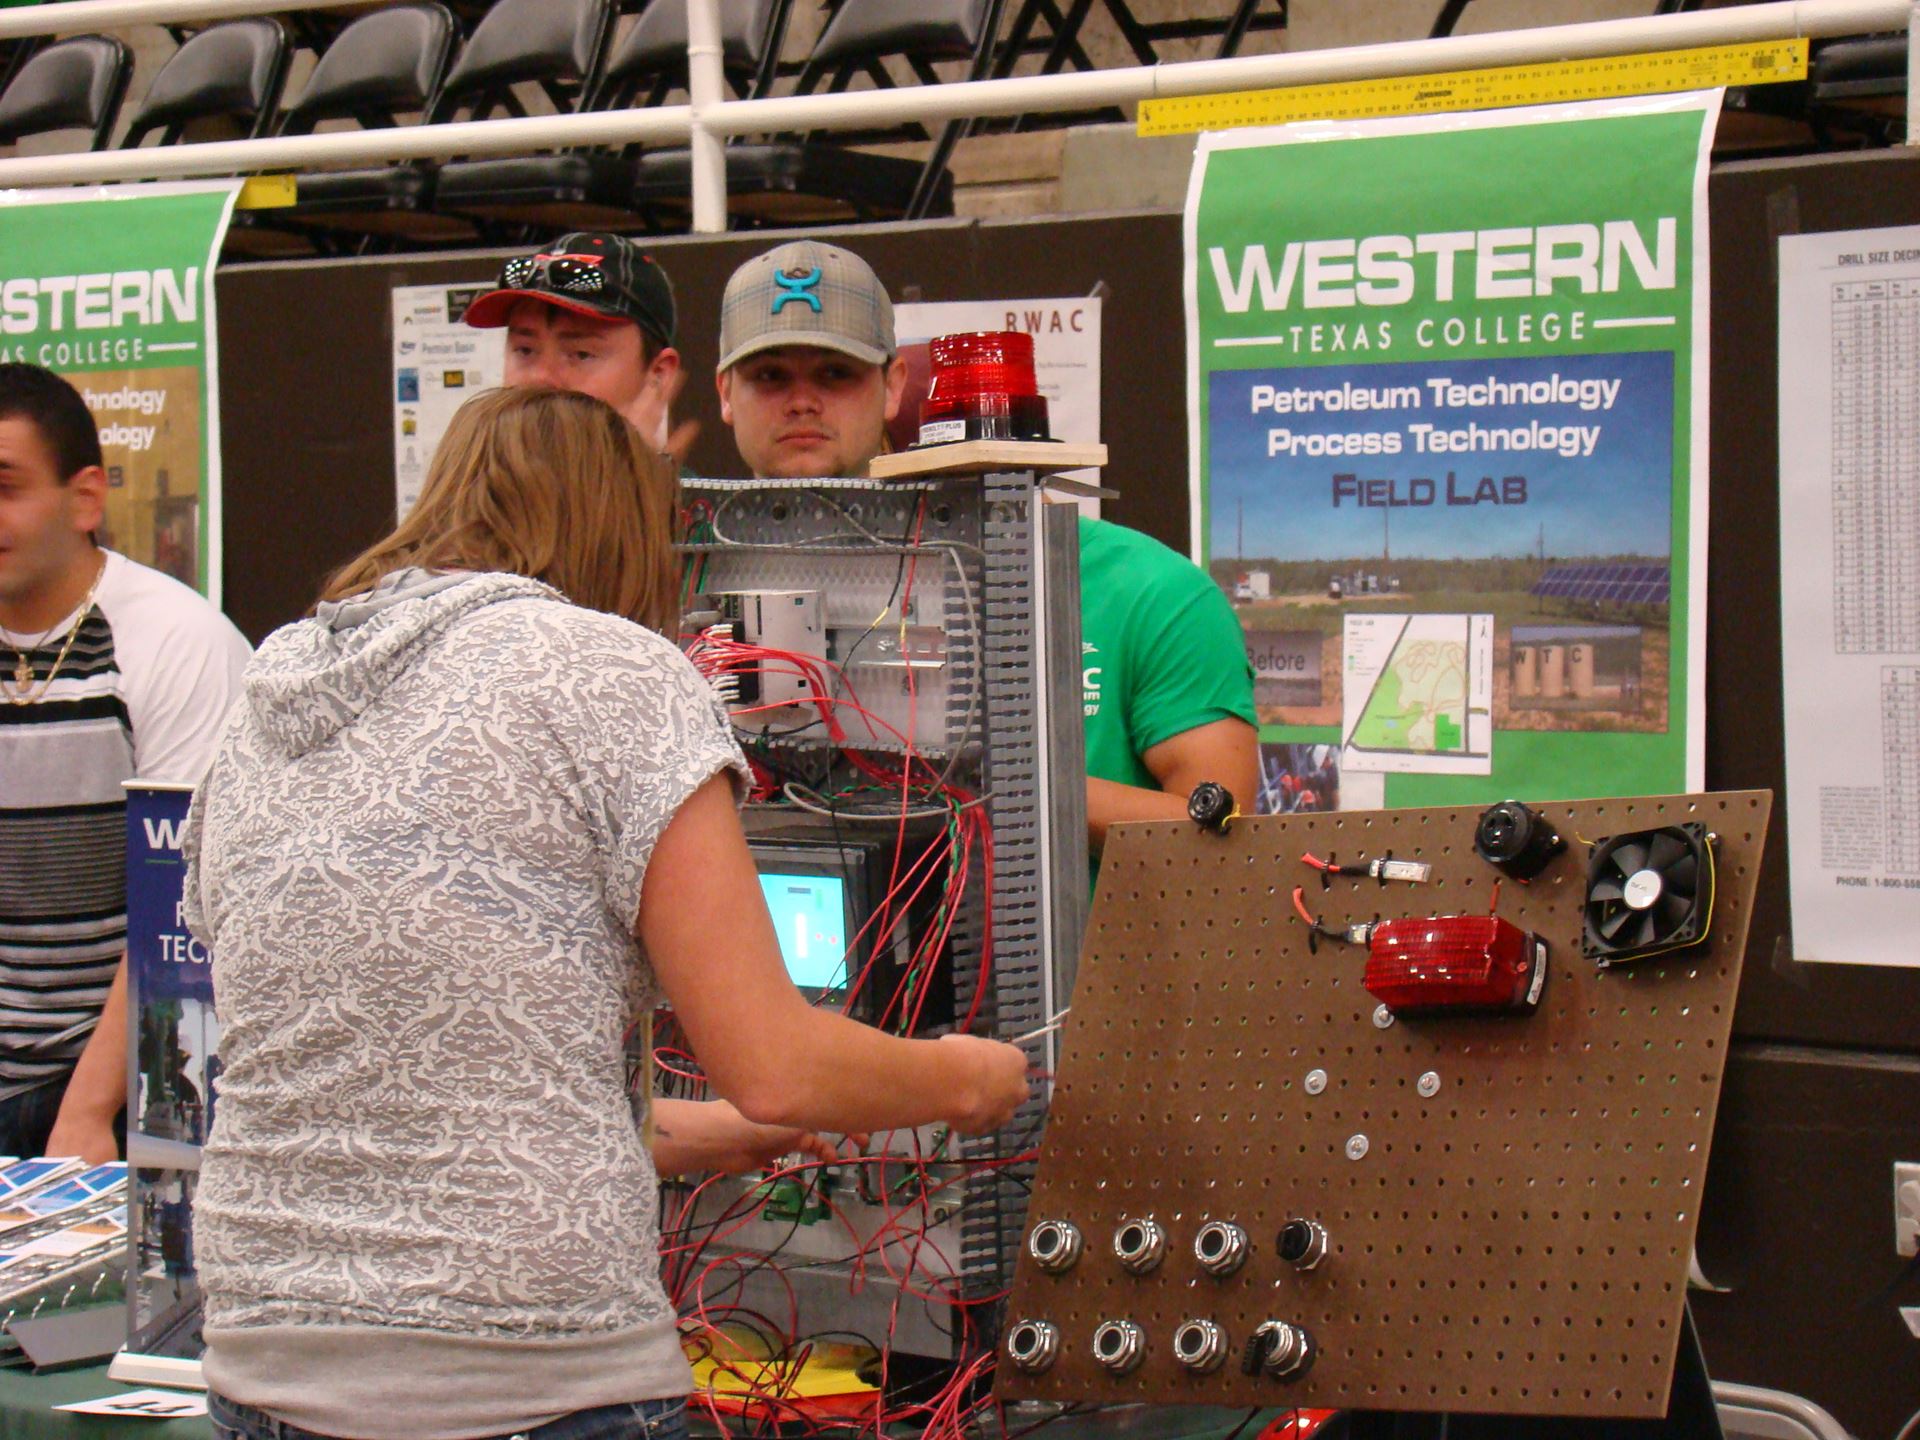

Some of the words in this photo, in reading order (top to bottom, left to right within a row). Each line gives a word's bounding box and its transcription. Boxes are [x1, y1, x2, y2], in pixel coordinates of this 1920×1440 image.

[1209, 217, 1676, 312] WESTERN
[1838, 254, 1864, 265] DRILL
[1868, 251, 1889, 263] SIZE
[0, 267, 198, 335] STERN
[1006, 309, 1083, 333] RWAC
[1291, 323, 1391, 354] TEXAS
[1416, 312, 1586, 347] COLLEGE
[39, 337, 144, 367] COLLEGE
[1252, 382, 1421, 414] Petroleum
[1427, 374, 1621, 411] Technology
[98, 422, 155, 451] ology
[1268, 428, 1402, 457] Process
[1409, 421, 1601, 457] Technology
[1332, 473, 1436, 508] FIELD
[1446, 471, 1528, 505] LAB
